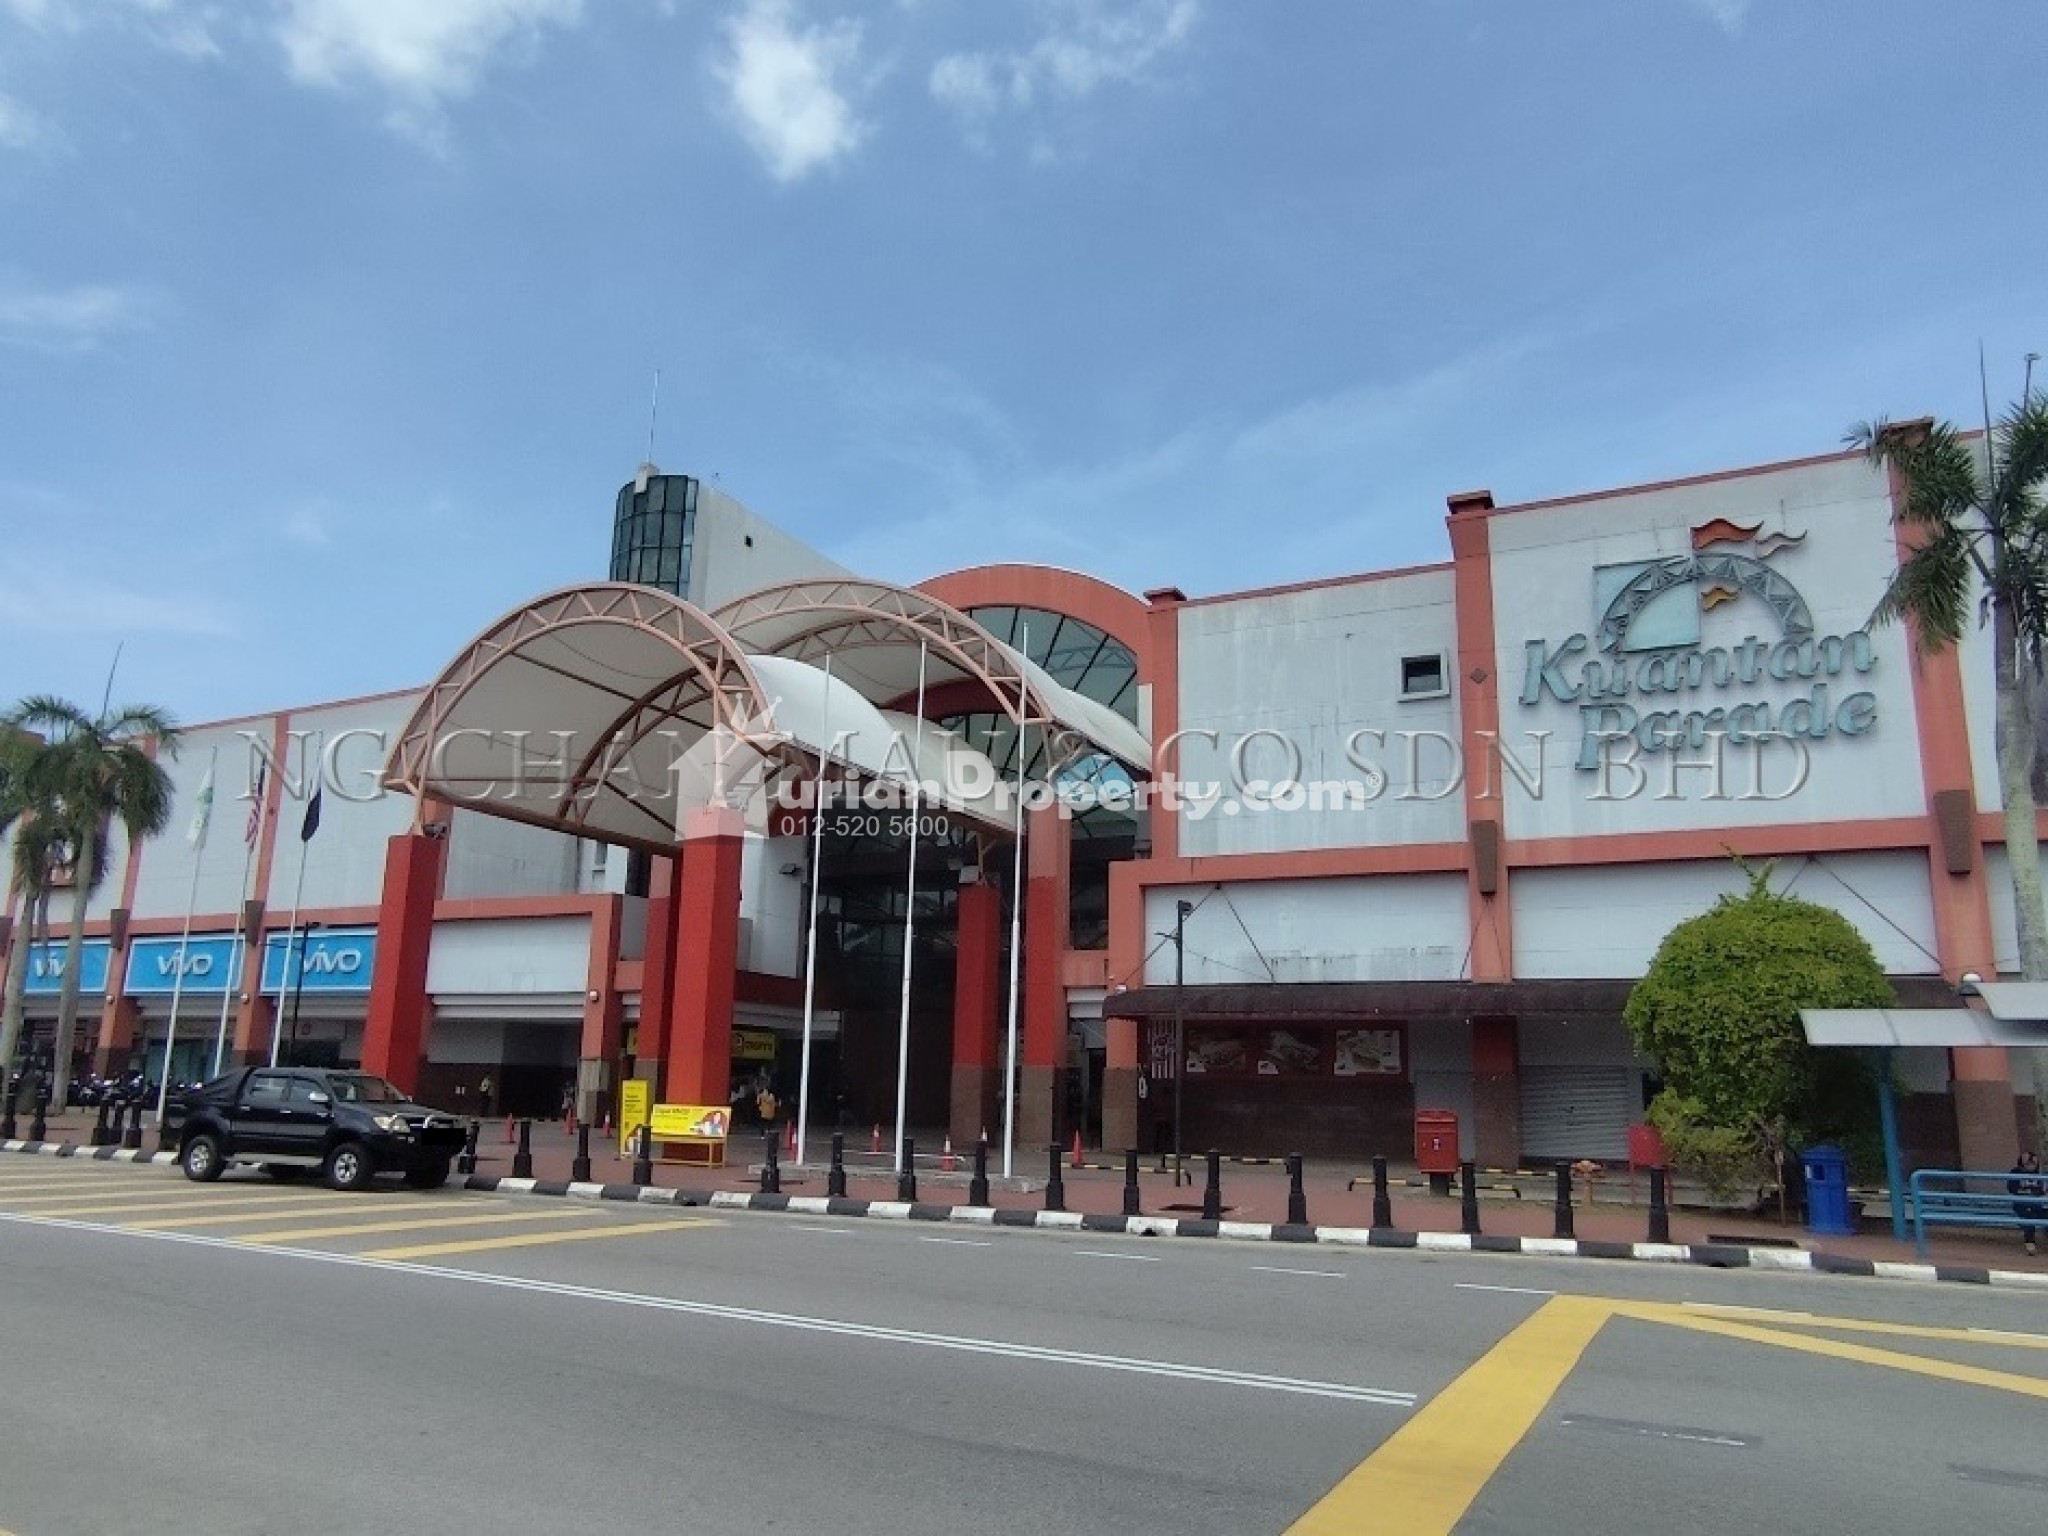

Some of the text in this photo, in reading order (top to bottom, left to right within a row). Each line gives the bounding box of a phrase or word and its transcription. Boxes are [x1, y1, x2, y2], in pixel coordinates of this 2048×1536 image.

[1518, 631, 1879, 705] Kuantan
[1575, 683, 1877, 770] Parade
[35, 951, 67, 978] viv
[301, 943, 362, 974] vivo
